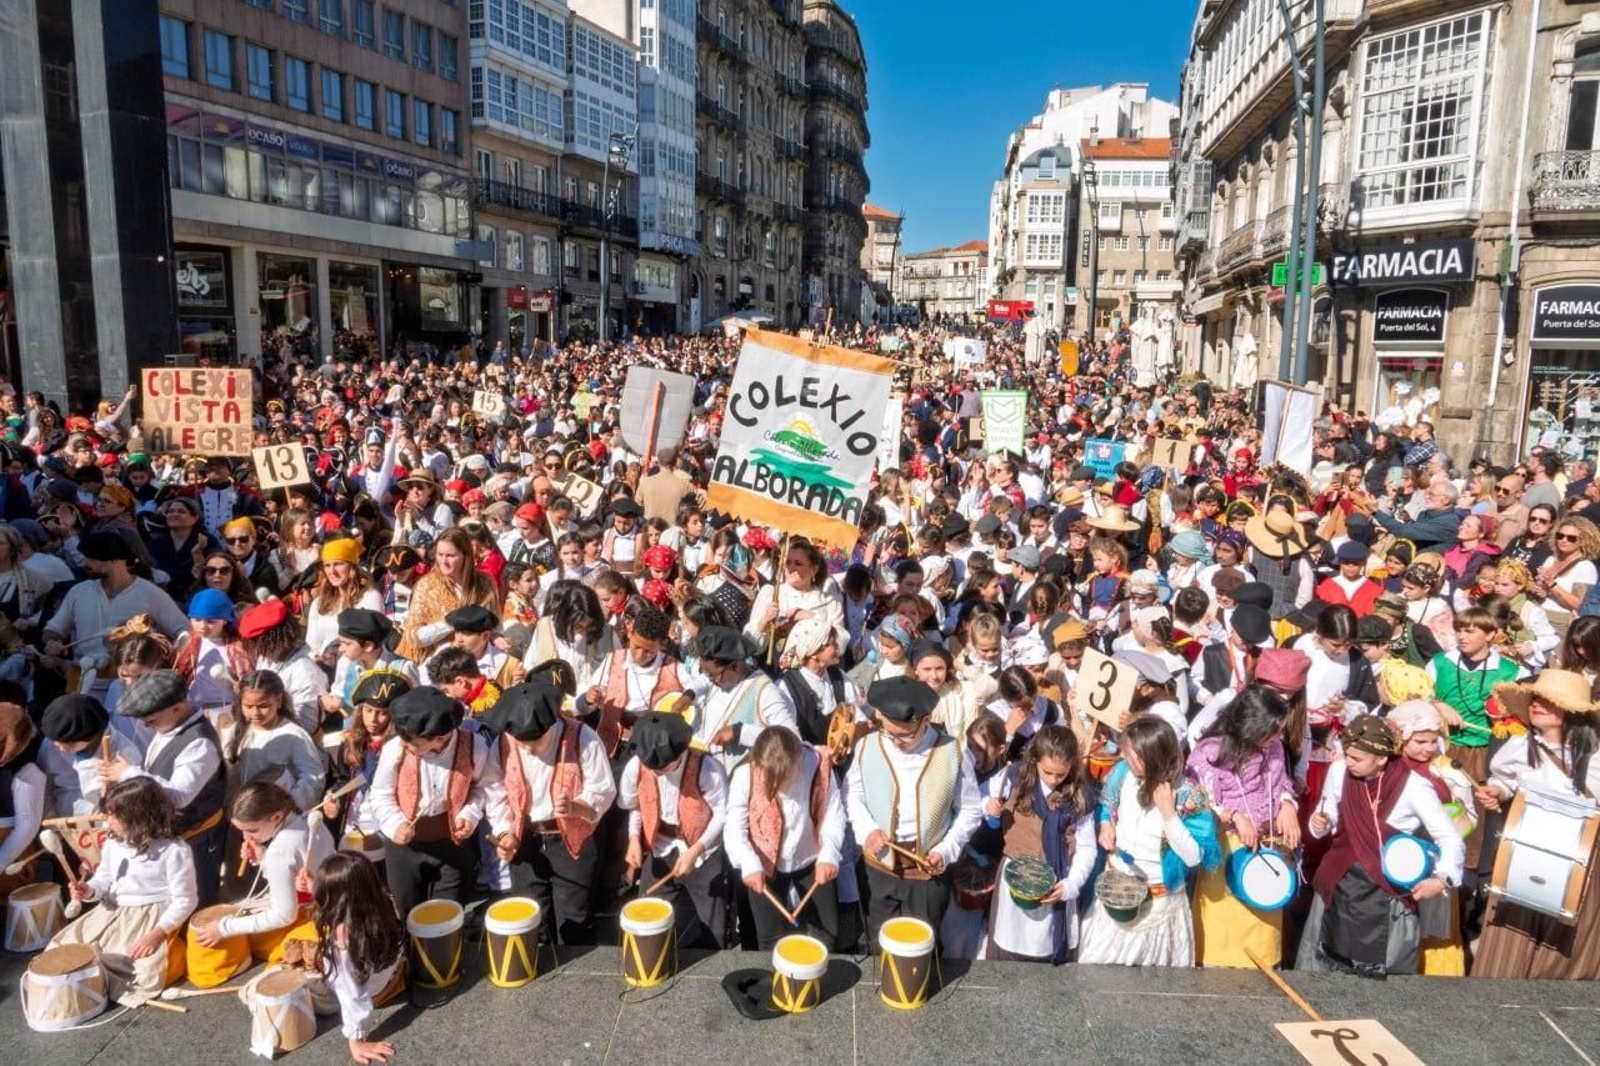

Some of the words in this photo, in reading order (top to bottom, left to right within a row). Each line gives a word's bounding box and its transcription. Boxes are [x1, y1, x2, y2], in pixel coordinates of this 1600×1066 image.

[249, 129, 283, 146] OCASO
[1332, 248, 1463, 280] FARMACIA
[1378, 305, 1441, 319] FARMACIA
[1543, 319, 1571, 328] Puerta
[1573, 319, 1587, 328] del
[1380, 323, 1403, 331] Puerta
[1404, 322, 1416, 331] del
[919, 368, 932, 382] 18
[479, 393, 497, 412] 15
[730, 375, 877, 456] COLEXIO
[151, 426, 250, 452] ALEGRE
[262, 446, 298, 482] 13
[1167, 441, 1177, 464] 1
[562, 473, 593, 509] 12
[713, 455, 863, 525] ALBORADA
[372, 682, 396, 699] N
[1089, 660, 1118, 711] 3
